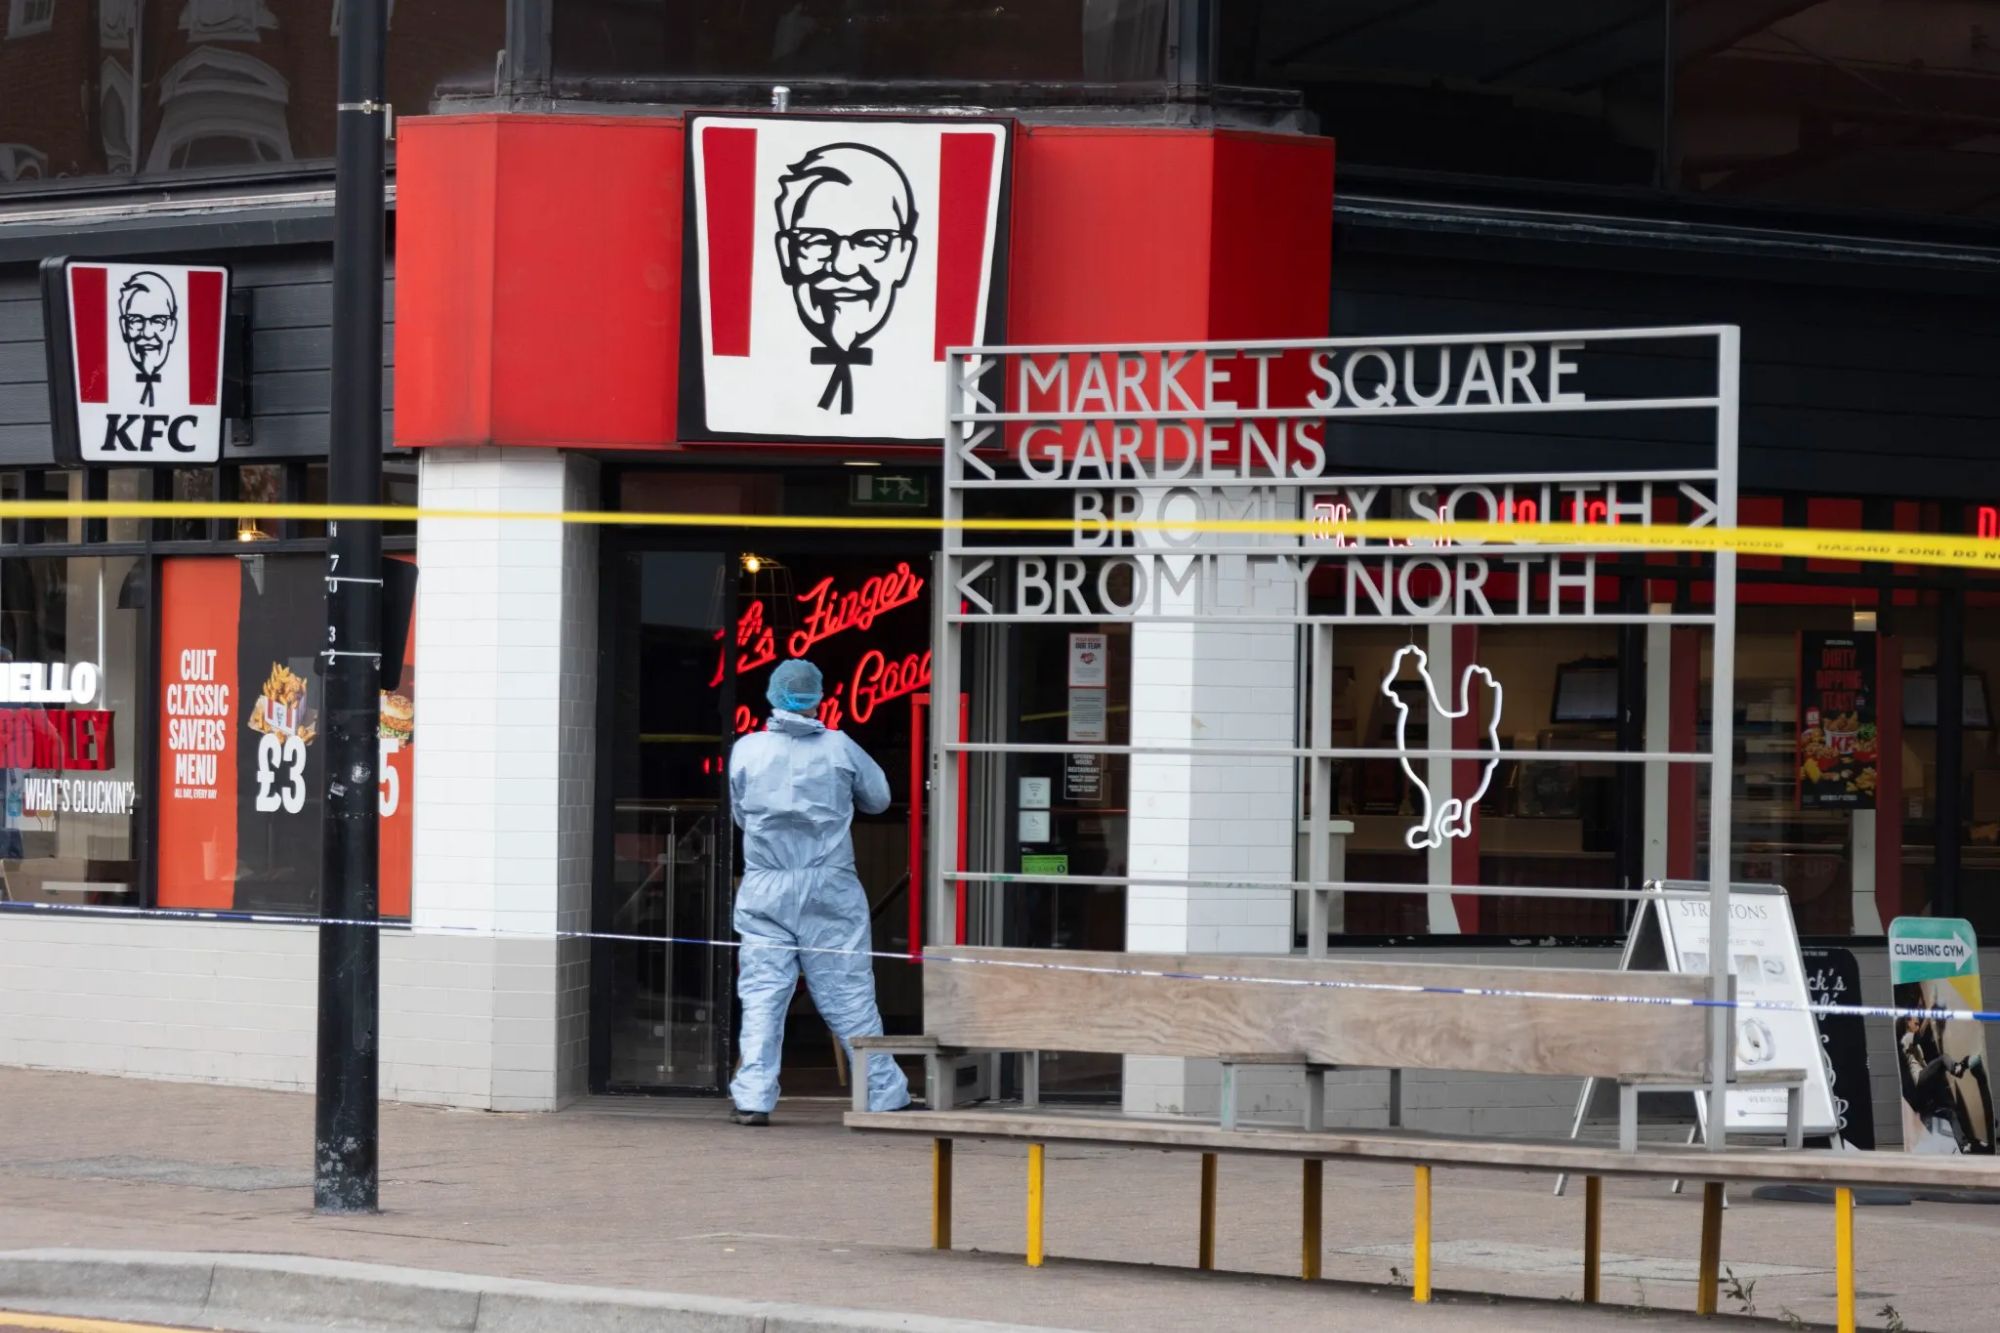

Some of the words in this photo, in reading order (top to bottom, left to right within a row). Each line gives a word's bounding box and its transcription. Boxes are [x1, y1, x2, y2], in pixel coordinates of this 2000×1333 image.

[1018, 350, 1284, 413] MARKET
[1307, 341, 1586, 409] SQUARE
[100, 413, 198, 452] KFC
[1018, 417, 1326, 480] GARDENS
[1409, 482, 1652, 545] SOUTH
[1897, 547, 1947, 557] ZONE
[1953, 549, 1978, 559] DO
[1017, 554, 1319, 615] BROMLEY
[1346, 554, 1595, 616] NORTH
[788, 562, 925, 657] Finger
[181, 649, 217, 681] CULT
[167, 684, 229, 716] CLASSIC
[169, 718, 225, 751] SAVERS
[175, 753, 217, 785] MENU
[256, 733, 307, 814] £3
[24, 777, 70, 812] WHAT'S
[73, 779, 136, 815] CLUCKIN'?
[1680, 900, 1769, 920] STRTONS
[1894, 943, 1941, 957] CLIMBING
[1943, 945, 1965, 957] GYM
[1808, 967, 1847, 991] ck's
